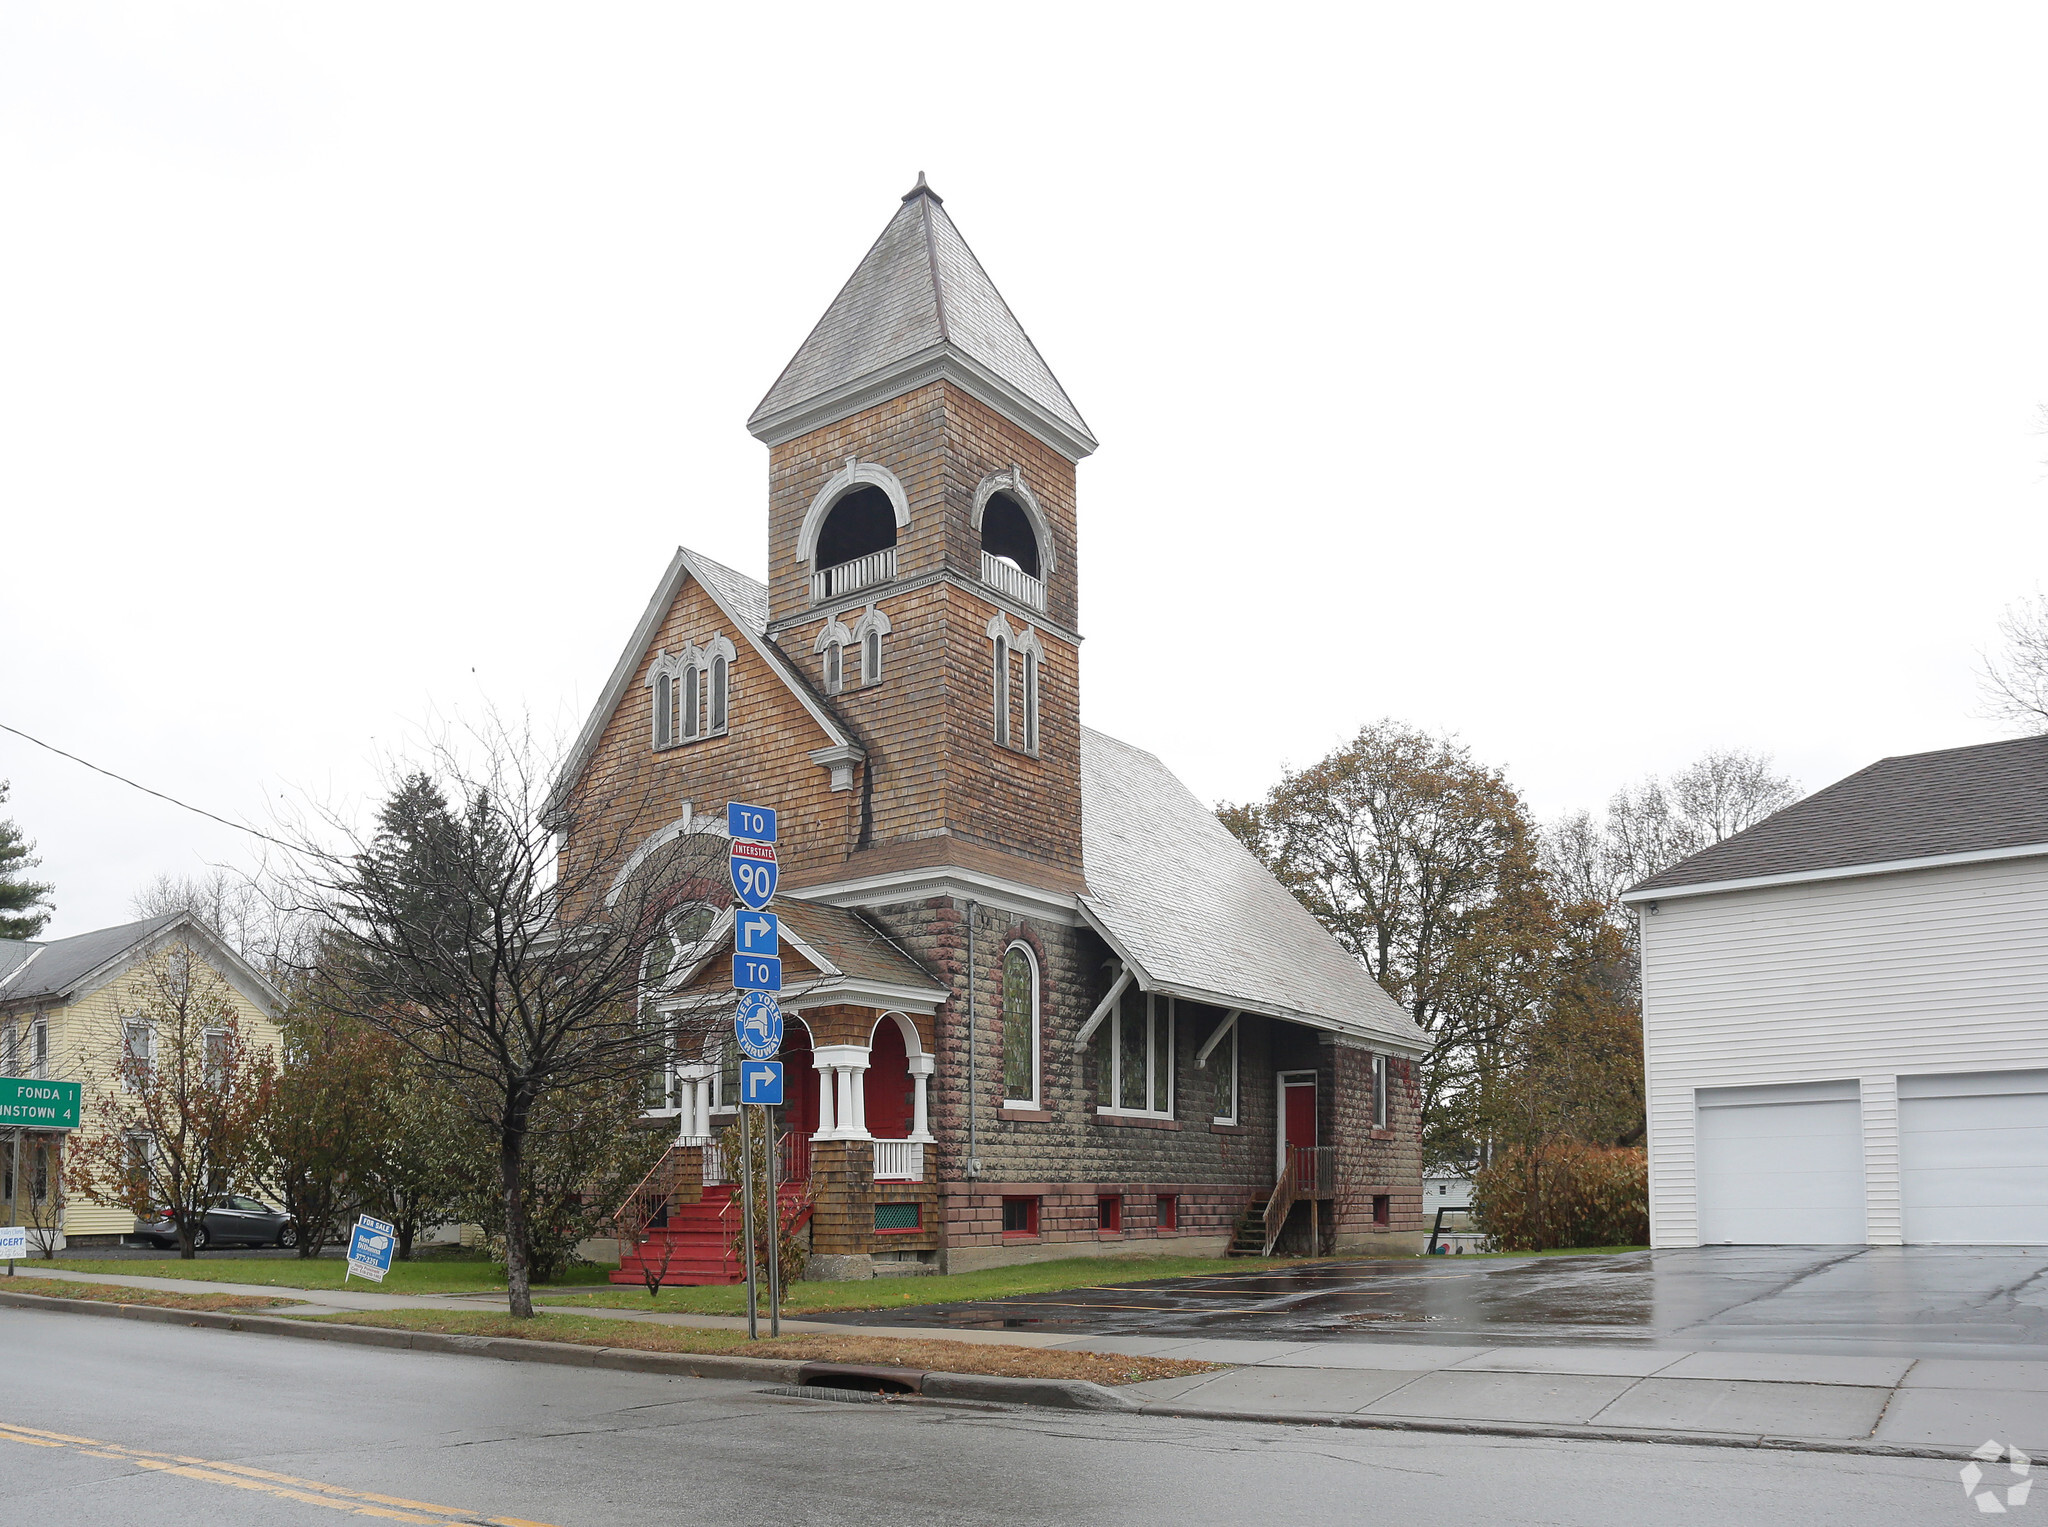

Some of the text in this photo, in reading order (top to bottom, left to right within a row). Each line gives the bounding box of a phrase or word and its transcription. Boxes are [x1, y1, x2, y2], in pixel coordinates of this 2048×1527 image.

[741, 811, 764, 834] TO
[735, 844, 773, 858] INTERSTATE
[738, 863, 770, 898] 90
[746, 962, 769, 983] TO
[737, 993, 780, 1022] NEW YORK
[740, 1033, 780, 1057] THRUWAY
[17, 1086, 73, 1100] FONDA 1
[63, 1108, 71, 1119] 4
[363, 1218, 390, 1232] FOR SALE
